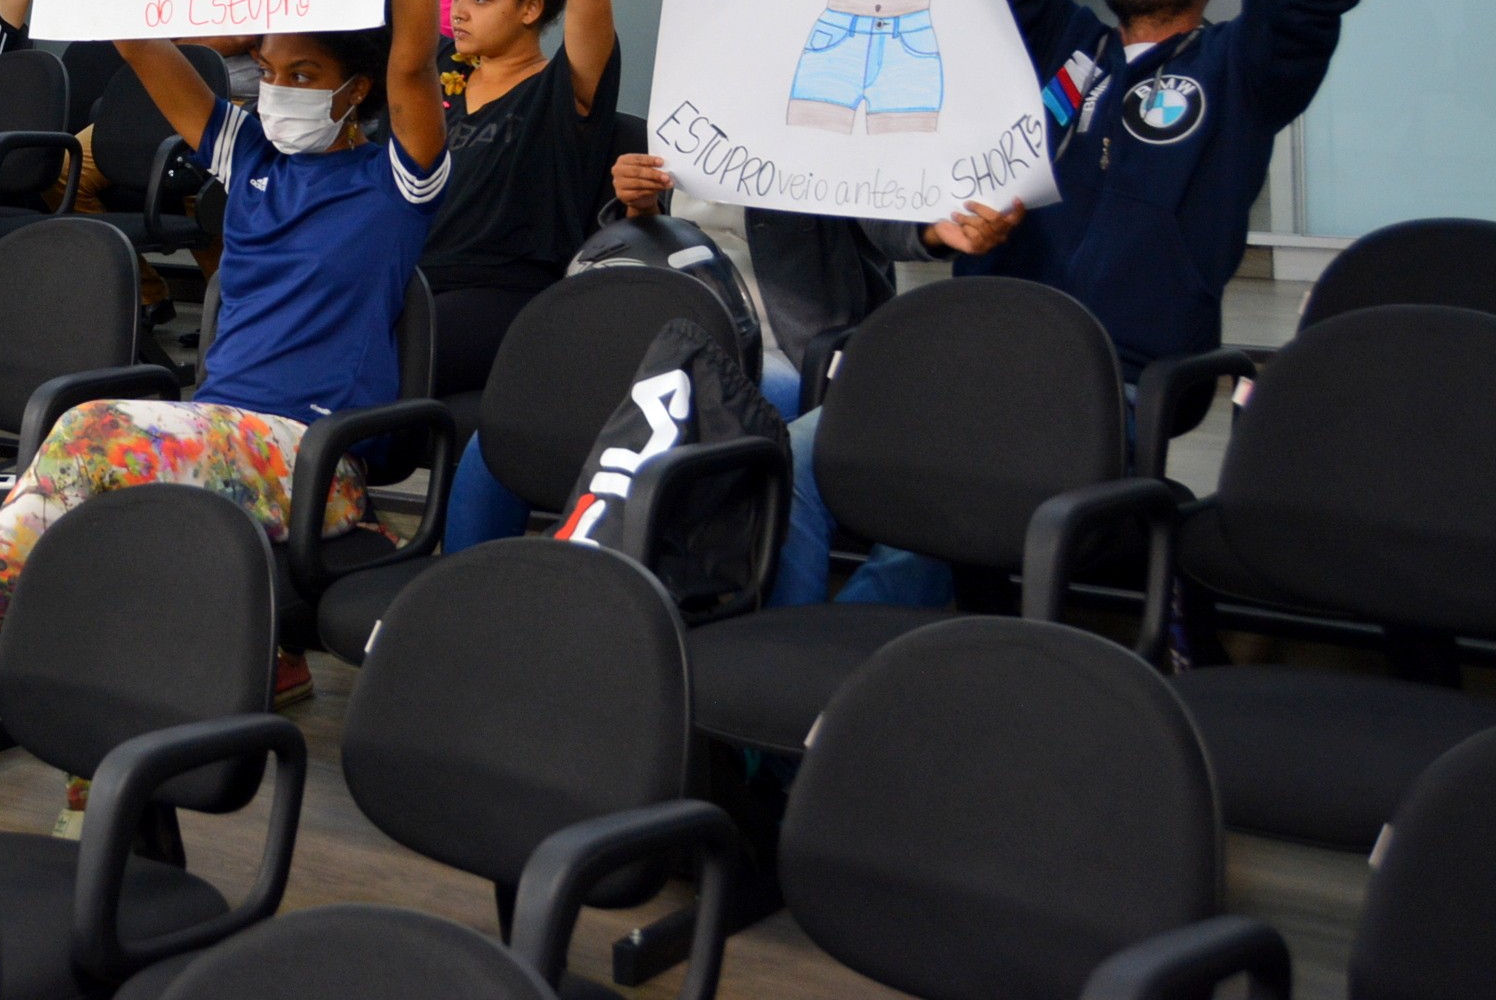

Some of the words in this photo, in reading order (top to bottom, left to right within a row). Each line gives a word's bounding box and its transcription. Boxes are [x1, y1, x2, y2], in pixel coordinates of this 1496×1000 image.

[1135, 78, 1196, 100] BMW
[655, 100, 776, 197] ESTUPRO
[778, 171, 829, 202] veio
[835, 168, 906, 209] antes
[911, 168, 942, 209] do
[951, 113, 1044, 200] SHORTS
